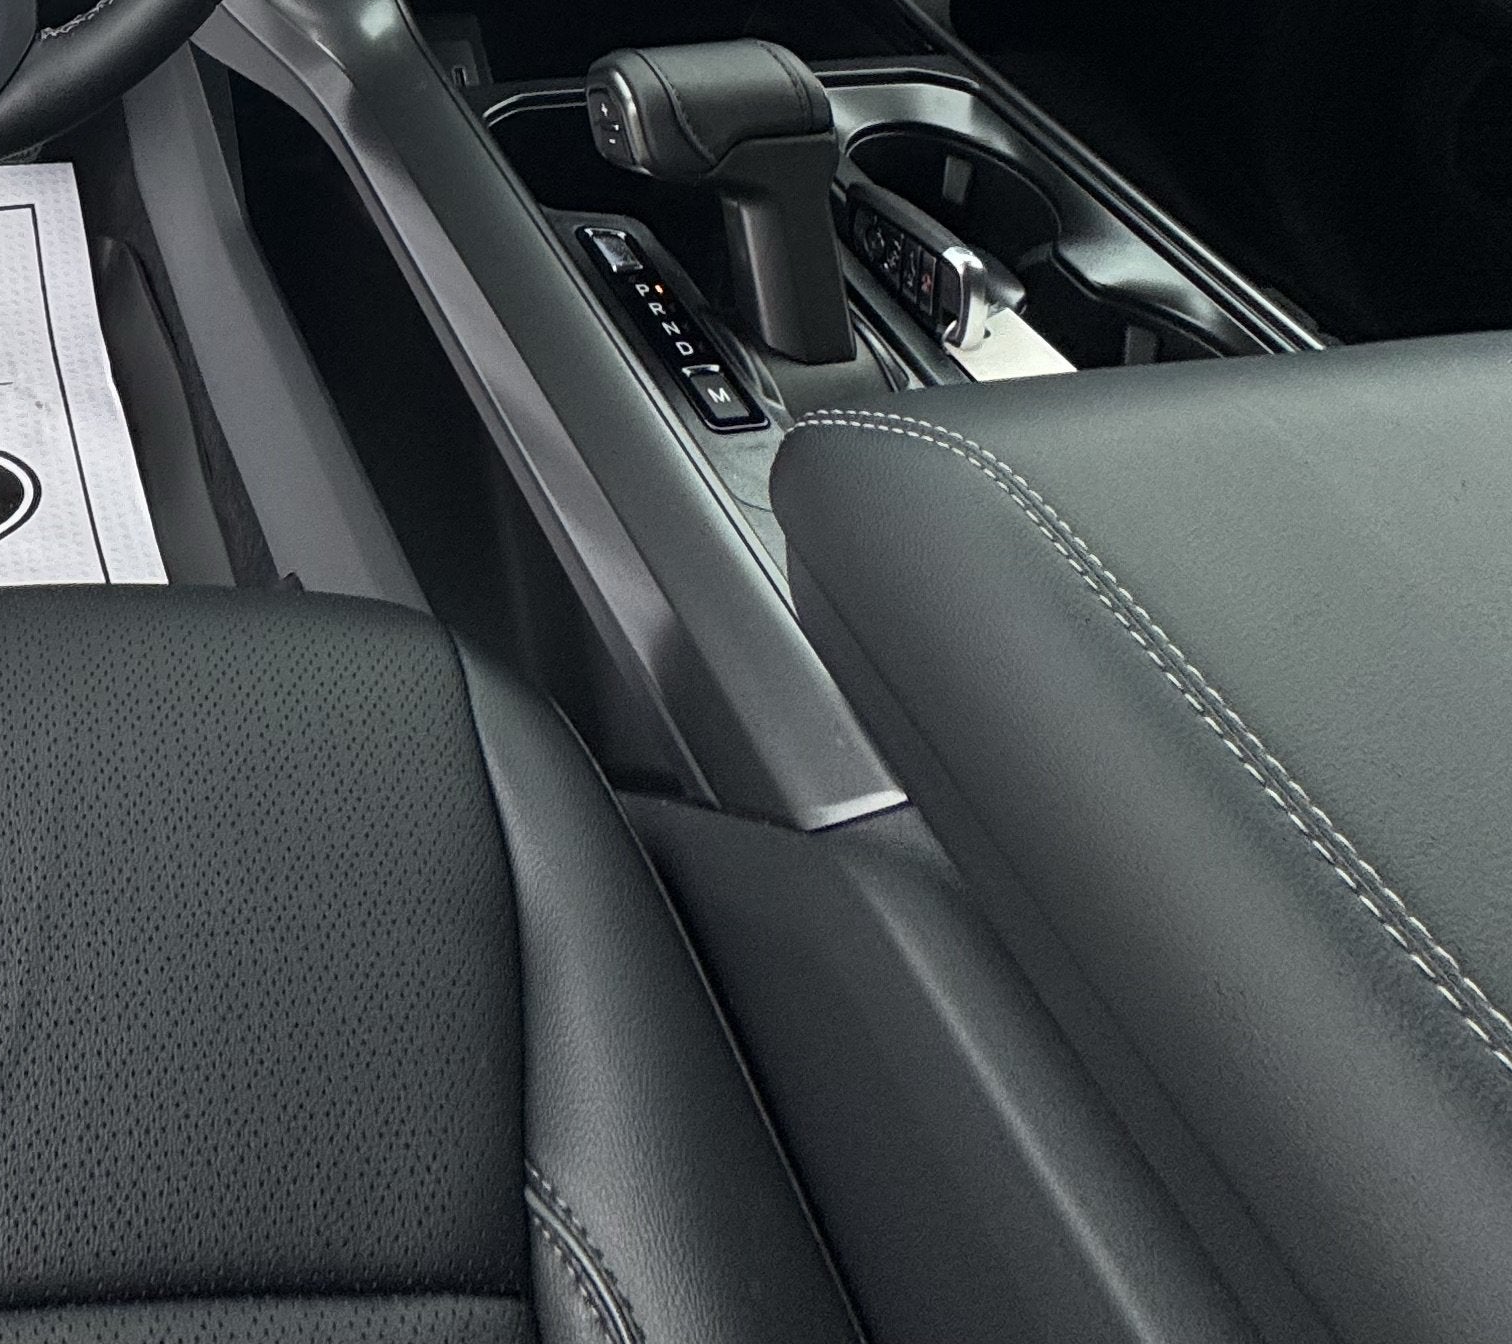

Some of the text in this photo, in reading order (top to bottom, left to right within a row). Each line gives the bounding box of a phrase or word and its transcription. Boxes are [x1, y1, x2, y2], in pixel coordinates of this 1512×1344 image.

[635, 283, 650, 297] P
[648, 302, 666, 317] R
[662, 321, 680, 337] N
[676, 341, 693, 357] D
[708, 386, 731, 403] M
